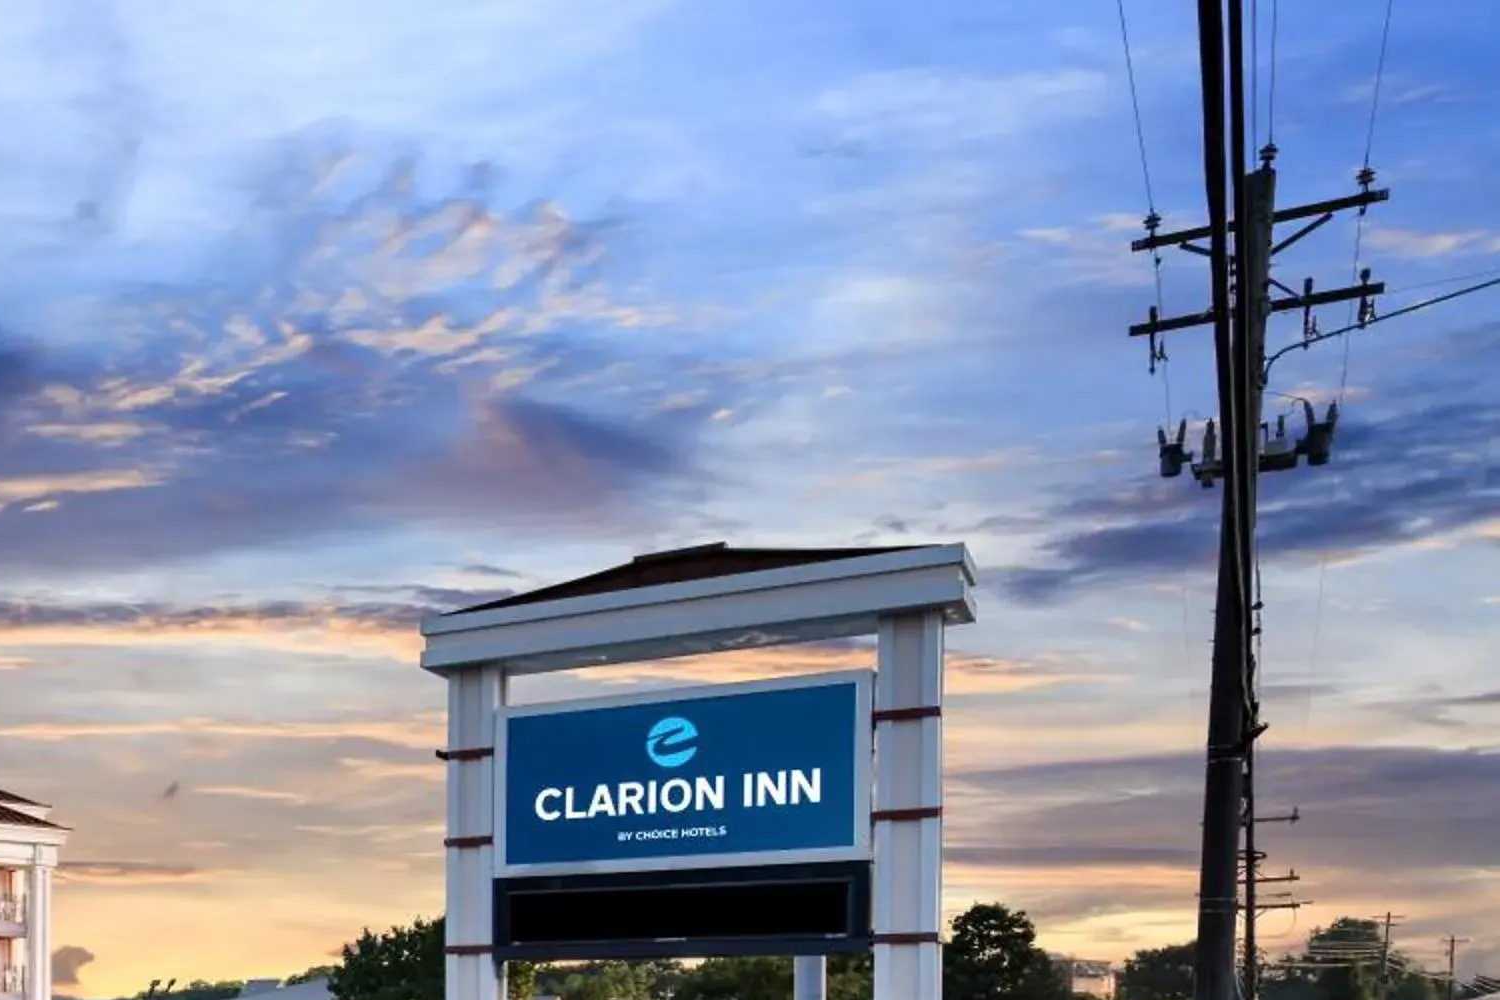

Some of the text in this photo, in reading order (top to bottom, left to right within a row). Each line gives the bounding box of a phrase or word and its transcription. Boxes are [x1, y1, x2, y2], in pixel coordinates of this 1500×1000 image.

[534, 767, 821, 821] CLARION INN
[617, 825, 727, 842] BY CHOICE HOTELS
